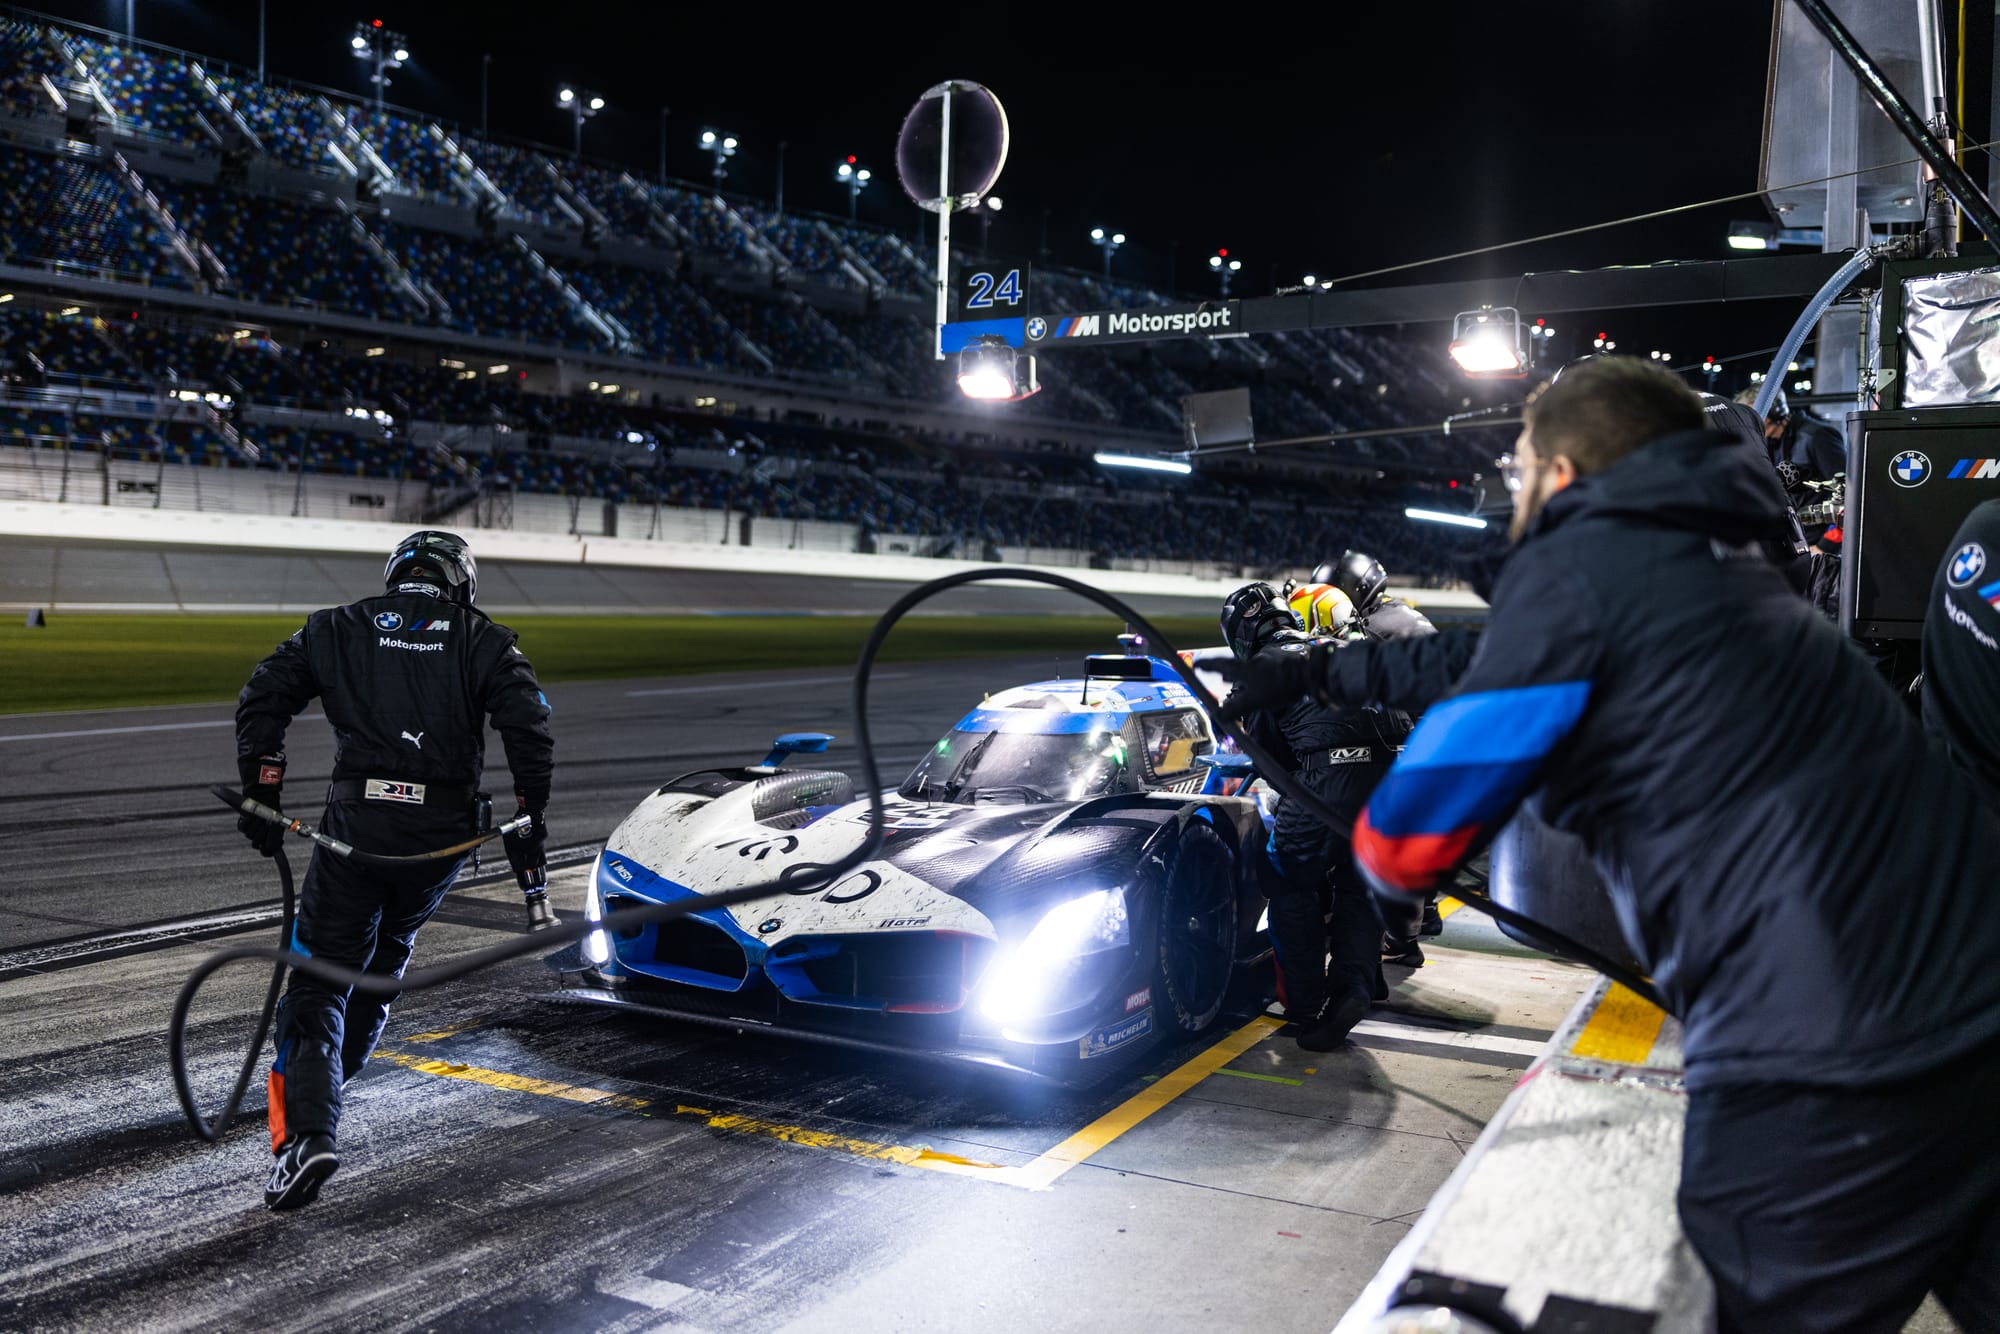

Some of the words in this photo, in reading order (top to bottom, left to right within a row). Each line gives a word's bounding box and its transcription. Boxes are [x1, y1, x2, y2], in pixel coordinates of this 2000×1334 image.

[966, 269, 1023, 309] 24
[1108, 306, 1231, 335] Motorsport
[379, 637, 444, 652] Motorsport
[1107, 1018, 1149, 1044] MICHELIN
